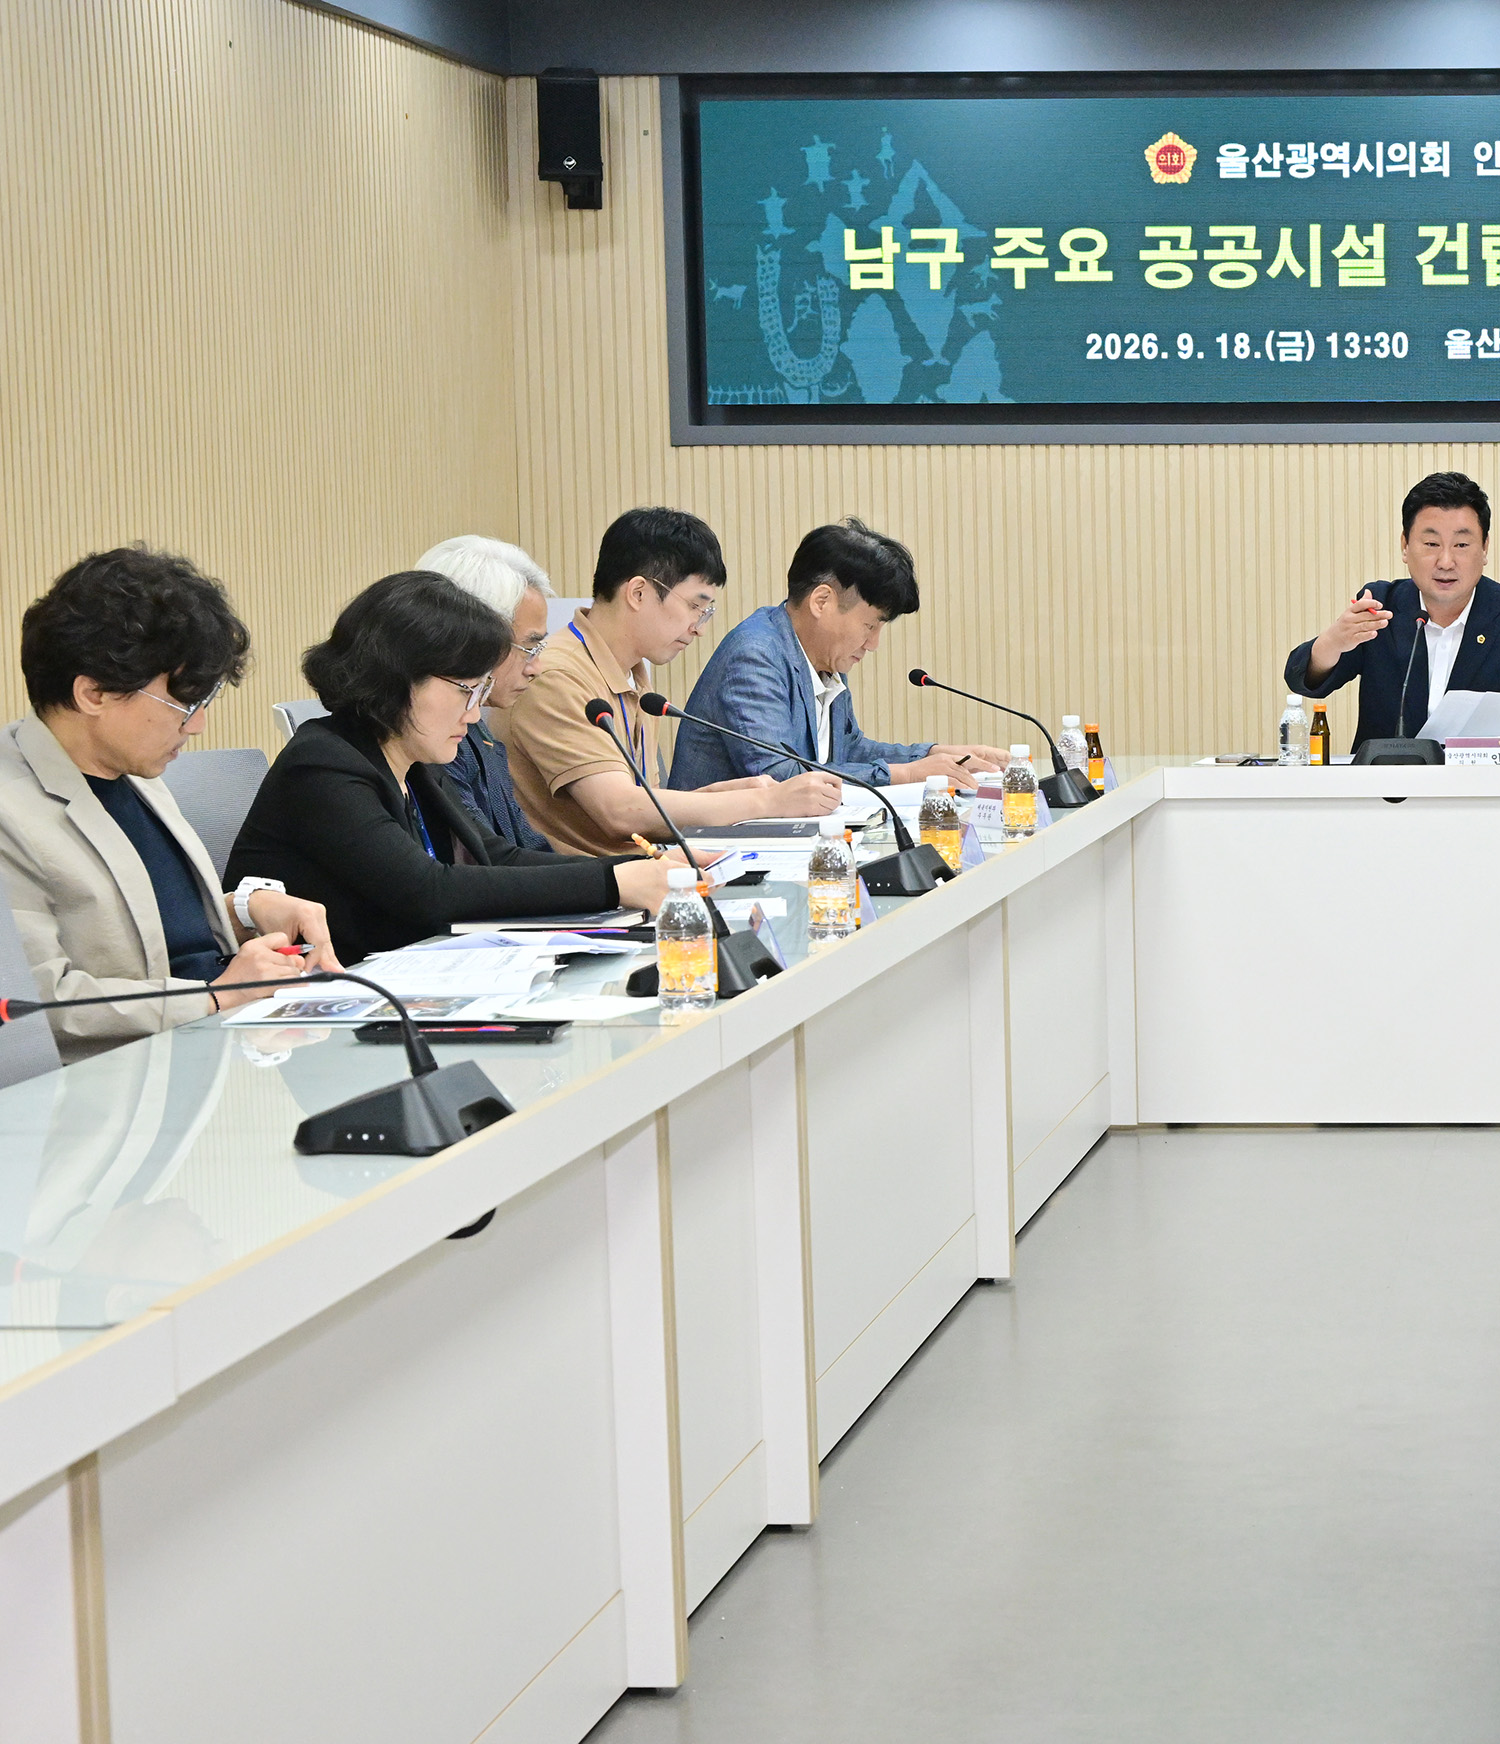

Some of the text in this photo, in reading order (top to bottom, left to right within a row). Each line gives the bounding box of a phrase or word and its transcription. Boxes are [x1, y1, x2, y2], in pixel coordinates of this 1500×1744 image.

[1157, 152, 1184, 166] 의회
[1217, 142, 1451, 180] 울산광역시의회
[845, 227, 965, 291] 남구
[991, 228, 1114, 291] 주요
[1140, 223, 1387, 290] 공공시설
[1085, 329, 1410, 363] 2026. 9. 18.(금) 13:30
